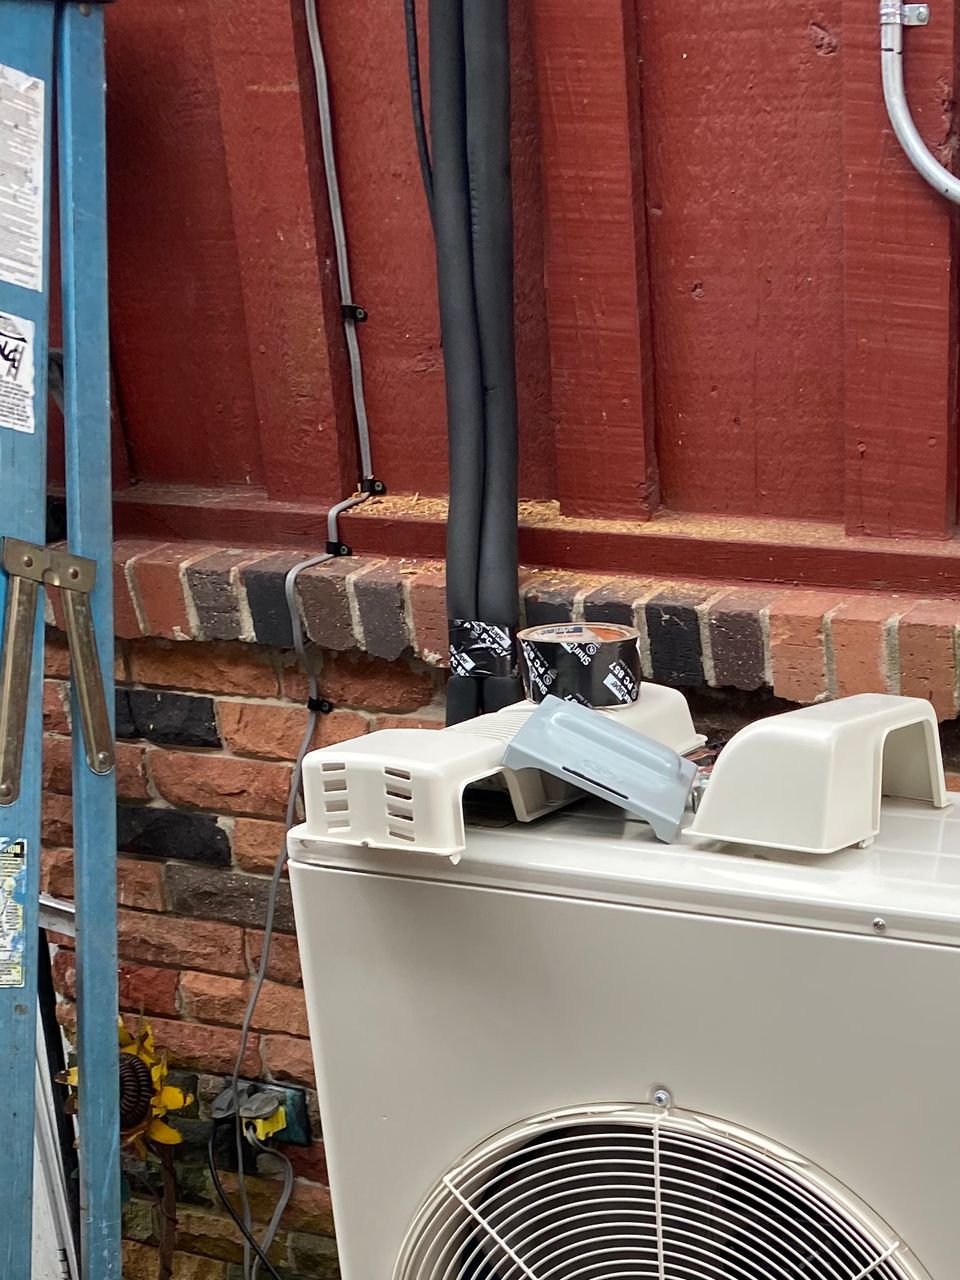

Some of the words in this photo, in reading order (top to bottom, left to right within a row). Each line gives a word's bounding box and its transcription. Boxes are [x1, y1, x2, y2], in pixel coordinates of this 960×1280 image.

[480, 632, 493, 645] PC
[533, 658, 546, 675] PC
[608, 661, 625, 679] 857
[623, 676, 635, 691] PC
